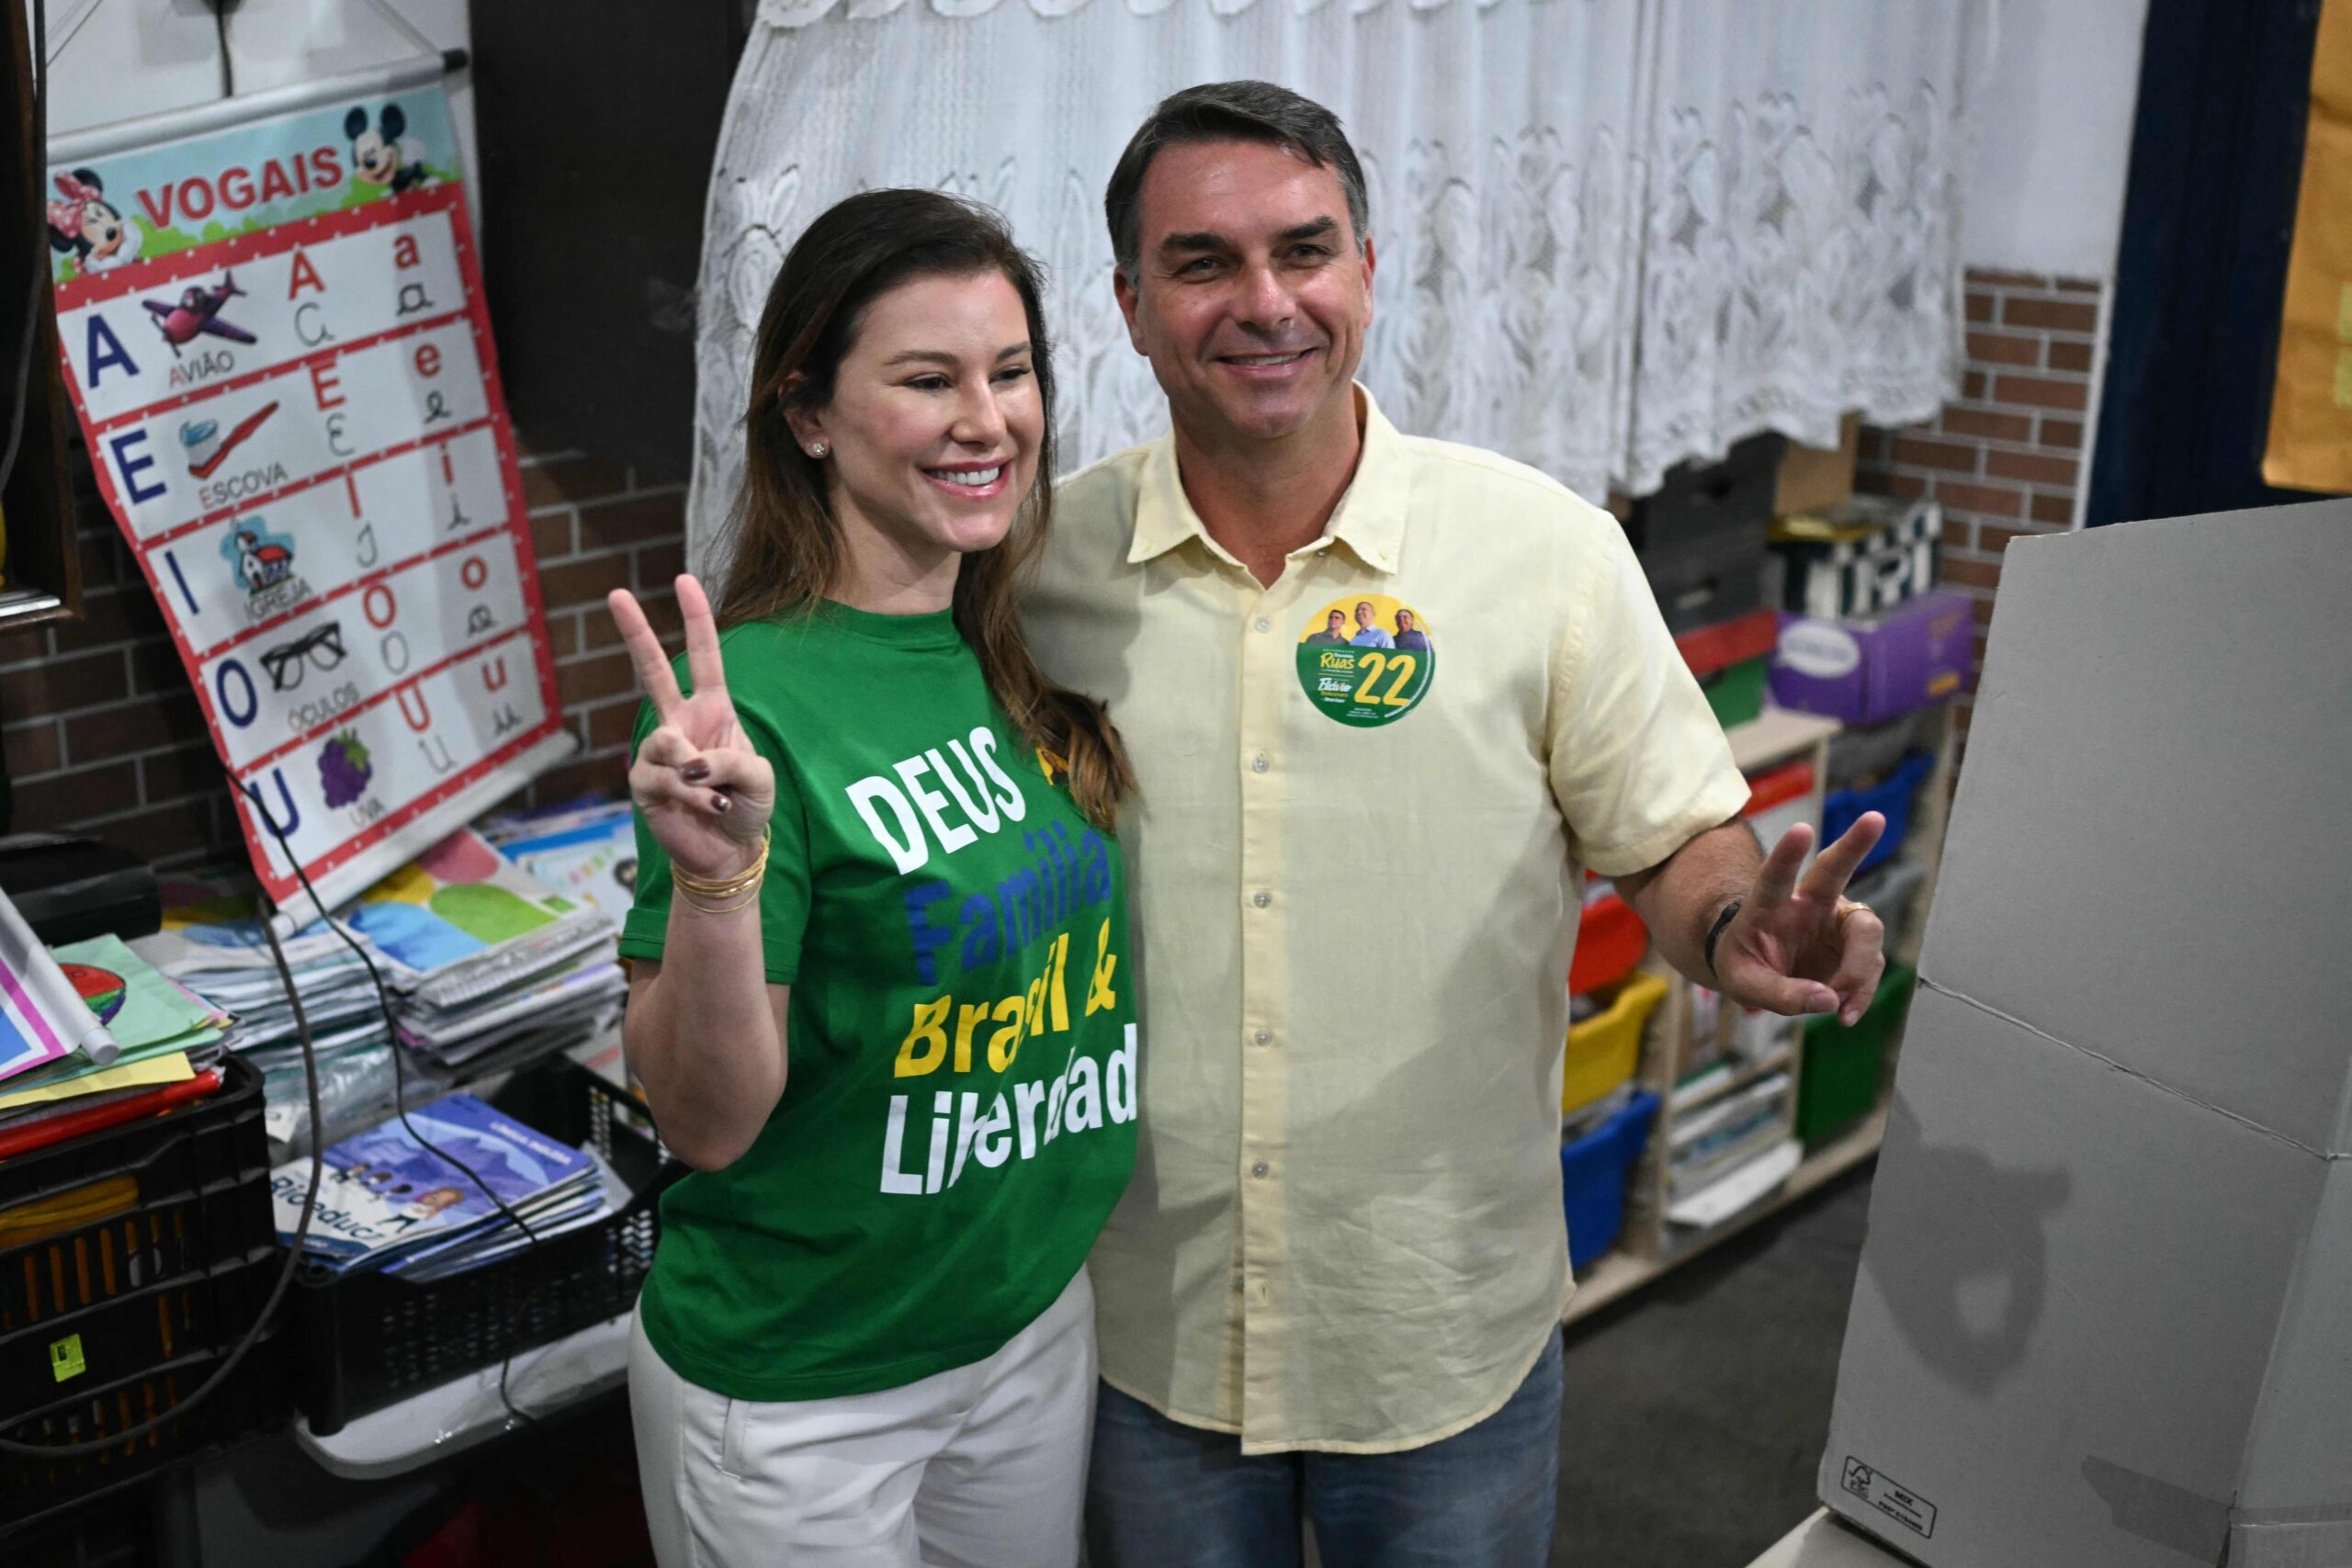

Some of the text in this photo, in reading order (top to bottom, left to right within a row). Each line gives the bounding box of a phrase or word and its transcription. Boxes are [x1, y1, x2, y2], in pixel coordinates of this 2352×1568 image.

[137, 146, 345, 229] VOGAIS
[288, 250, 326, 299] A
[394, 233, 422, 269] a
[87, 313, 140, 389] A
[169, 349, 235, 387] AVIÃO
[414, 343, 441, 378] e
[309, 359, 347, 411] E
[109, 428, 167, 505] E
[198, 461, 289, 510] ESCOVA
[164, 549, 200, 615] I
[460, 556, 488, 591] o
[242, 579, 313, 623] IGREJA
[363, 583, 396, 629] O
[216, 659, 258, 728] O
[481, 657, 506, 692] u
[1354, 651, 1416, 706] 22
[397, 682, 432, 732] U
[249, 767, 300, 840] U
[844, 726, 1026, 875] DEUS
